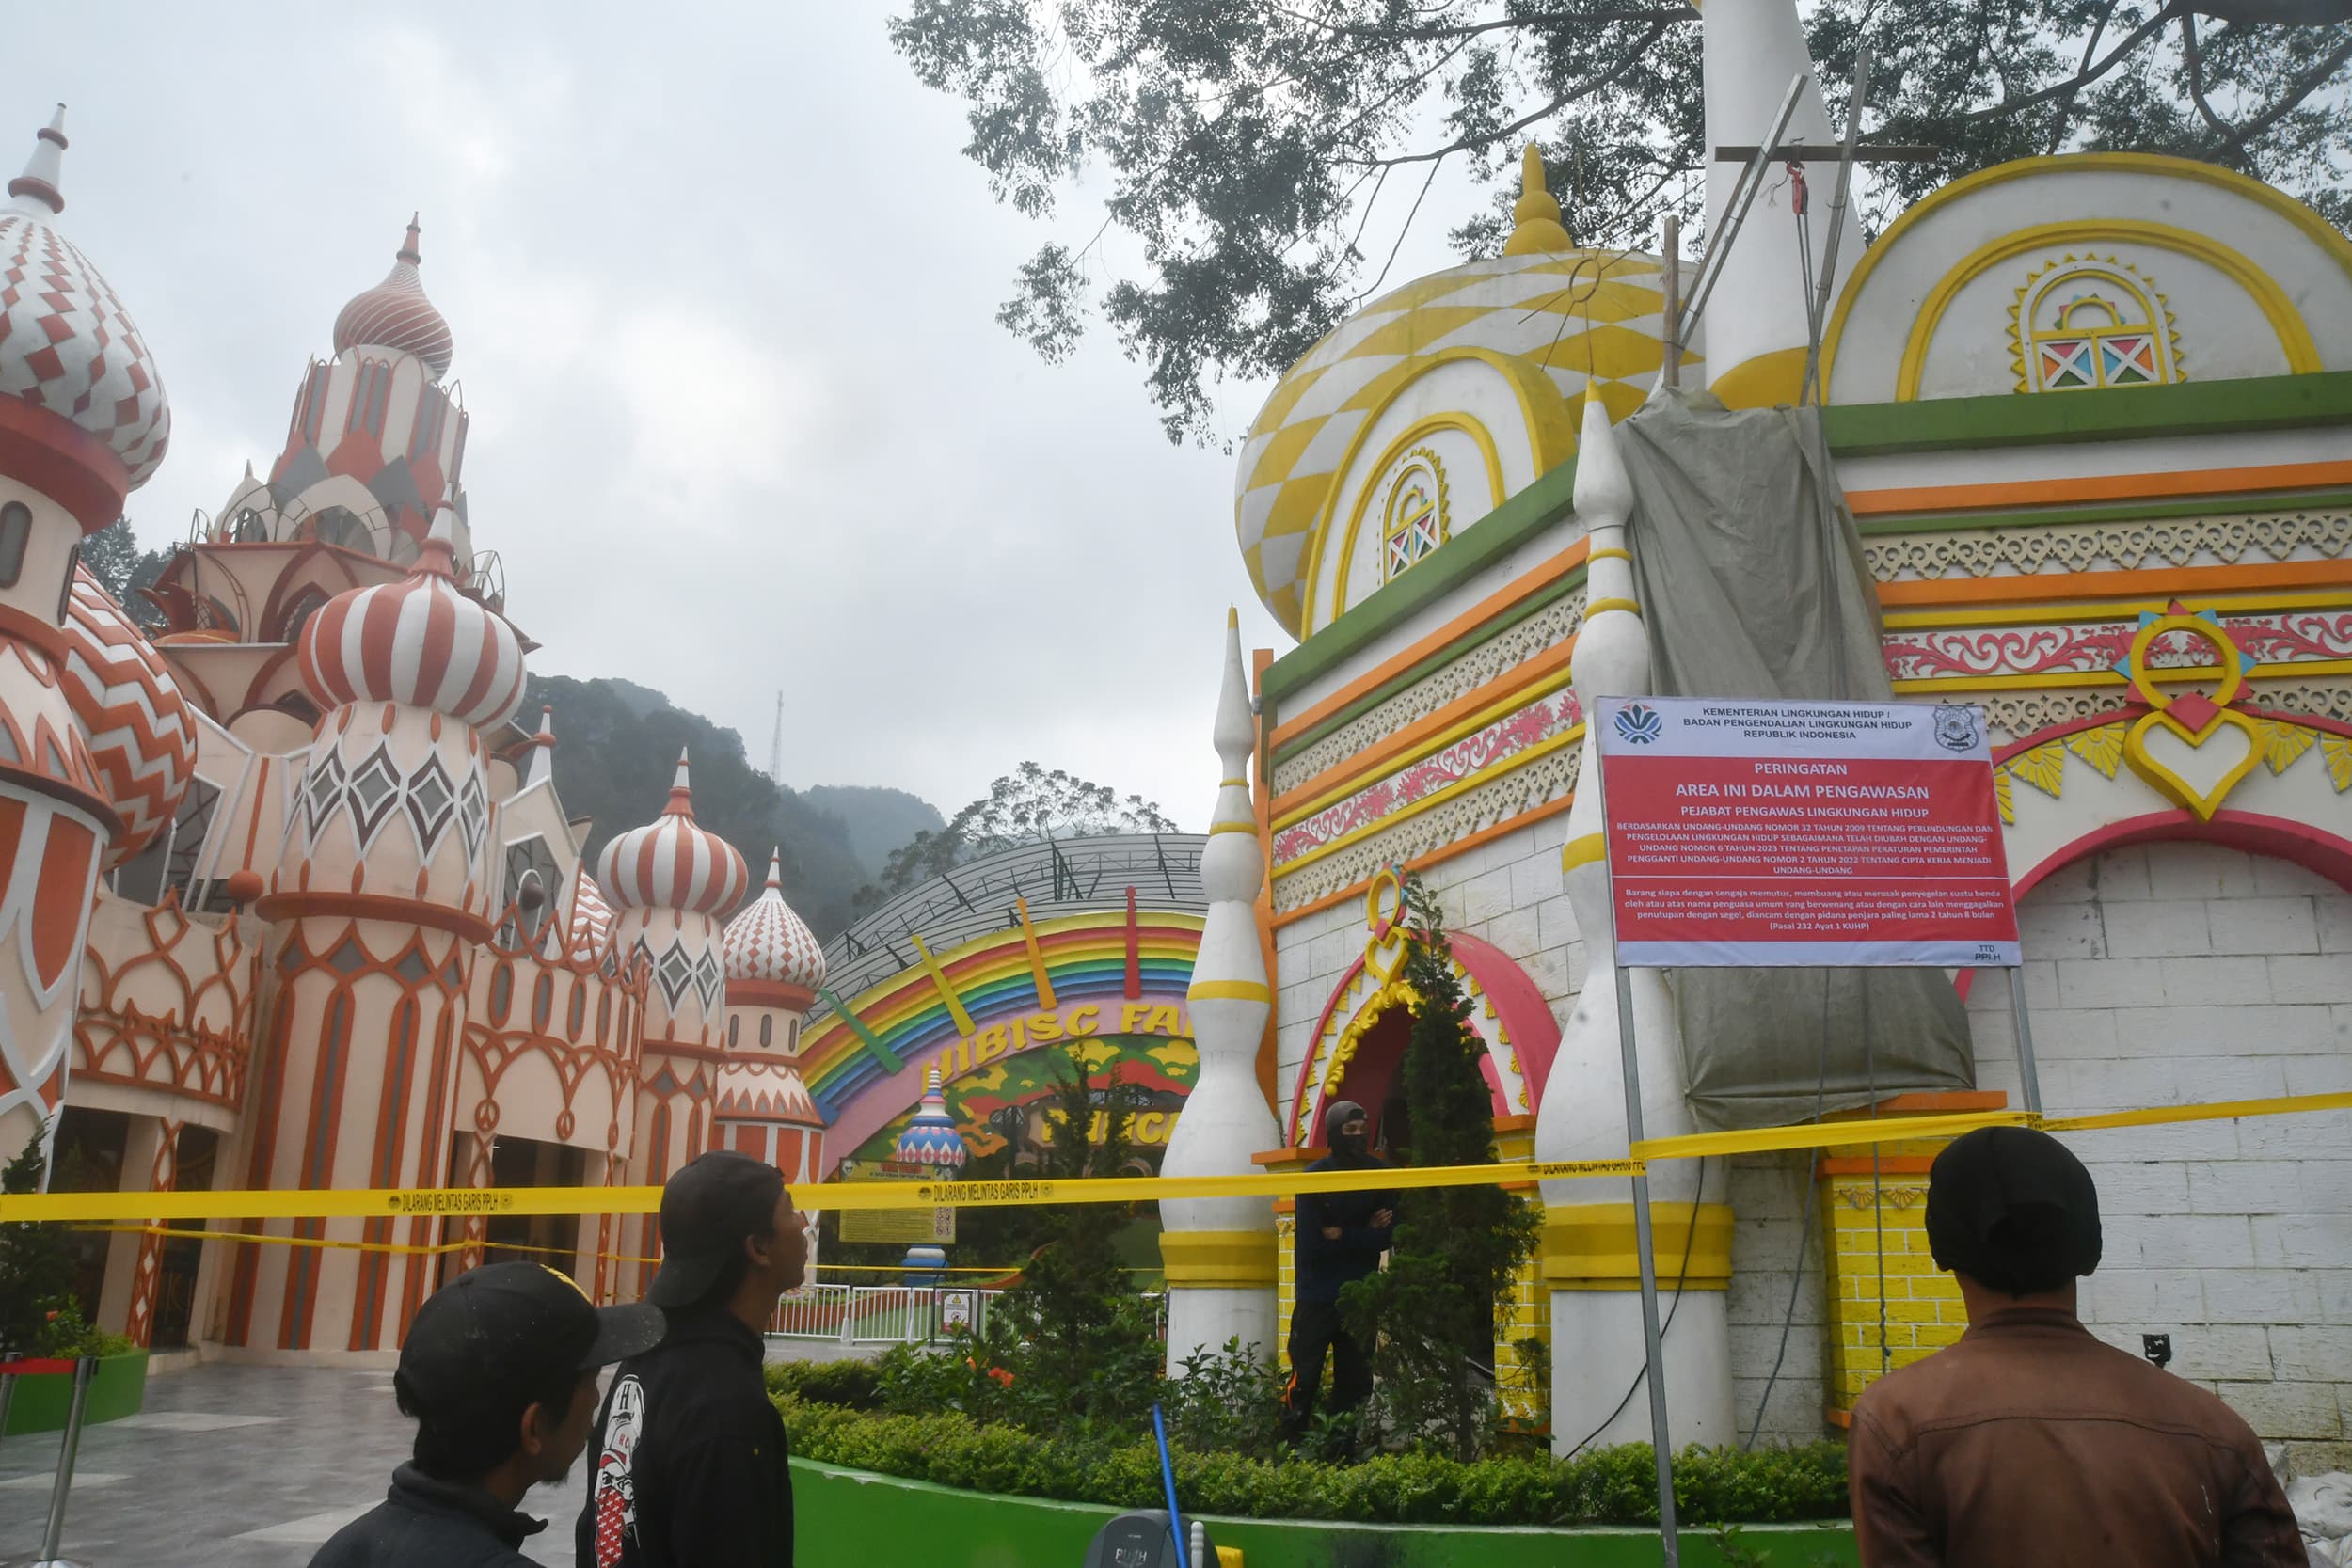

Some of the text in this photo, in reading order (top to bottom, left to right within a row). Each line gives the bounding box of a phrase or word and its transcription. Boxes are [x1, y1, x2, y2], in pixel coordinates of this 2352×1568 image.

[1703, 708, 1778, 717] KEMENTERIAN
[1781, 709, 1850, 718] LINGKUNGAN
[1724, 719, 1805, 728] PENGENDALIAN
[1809, 721, 1878, 729] LINGKUNGAN
[1744, 730, 1857, 739] REPUBLIK INDONESIA
[1755, 763, 1848, 775] PERINGATAN
[1676, 784, 1930, 799] AREA INI DALAM PENGAWASAN
[1681, 806, 1929, 818] PEJABAT PENGAWAS LINGKUNGAN HIDUP
[1626, 889, 1656, 897] Barang
[1658, 889, 1680, 897] siapa
[1682, 889, 1714, 897] dengan
[1794, 890, 1842, 898] membuang
[1901, 890, 1948, 898] penyegelan
[1686, 911, 1718, 920] dengan
[1720, 911, 1744, 920] segel,
[1784, 911, 1816, 920] dengan
[1817, 911, 1846, 920] pidana
[1848, 911, 1880, 920] penjara
[1882, 911, 1907, 920] paling
[1770, 922, 1795, 931] (Pasal
[1797, 922, 1812, 930] 232
[1814, 922, 1834, 931] Ayat
[1842, 922, 1869, 931] KUHP)
[1975, 953, 2001, 961] PPLH
[934, 1182, 1038, 1202] DILARANG MELINTAS GARIS PPLH
[403, 1194, 498, 1212] DILARANG MELINTAS GARIS PPLH
